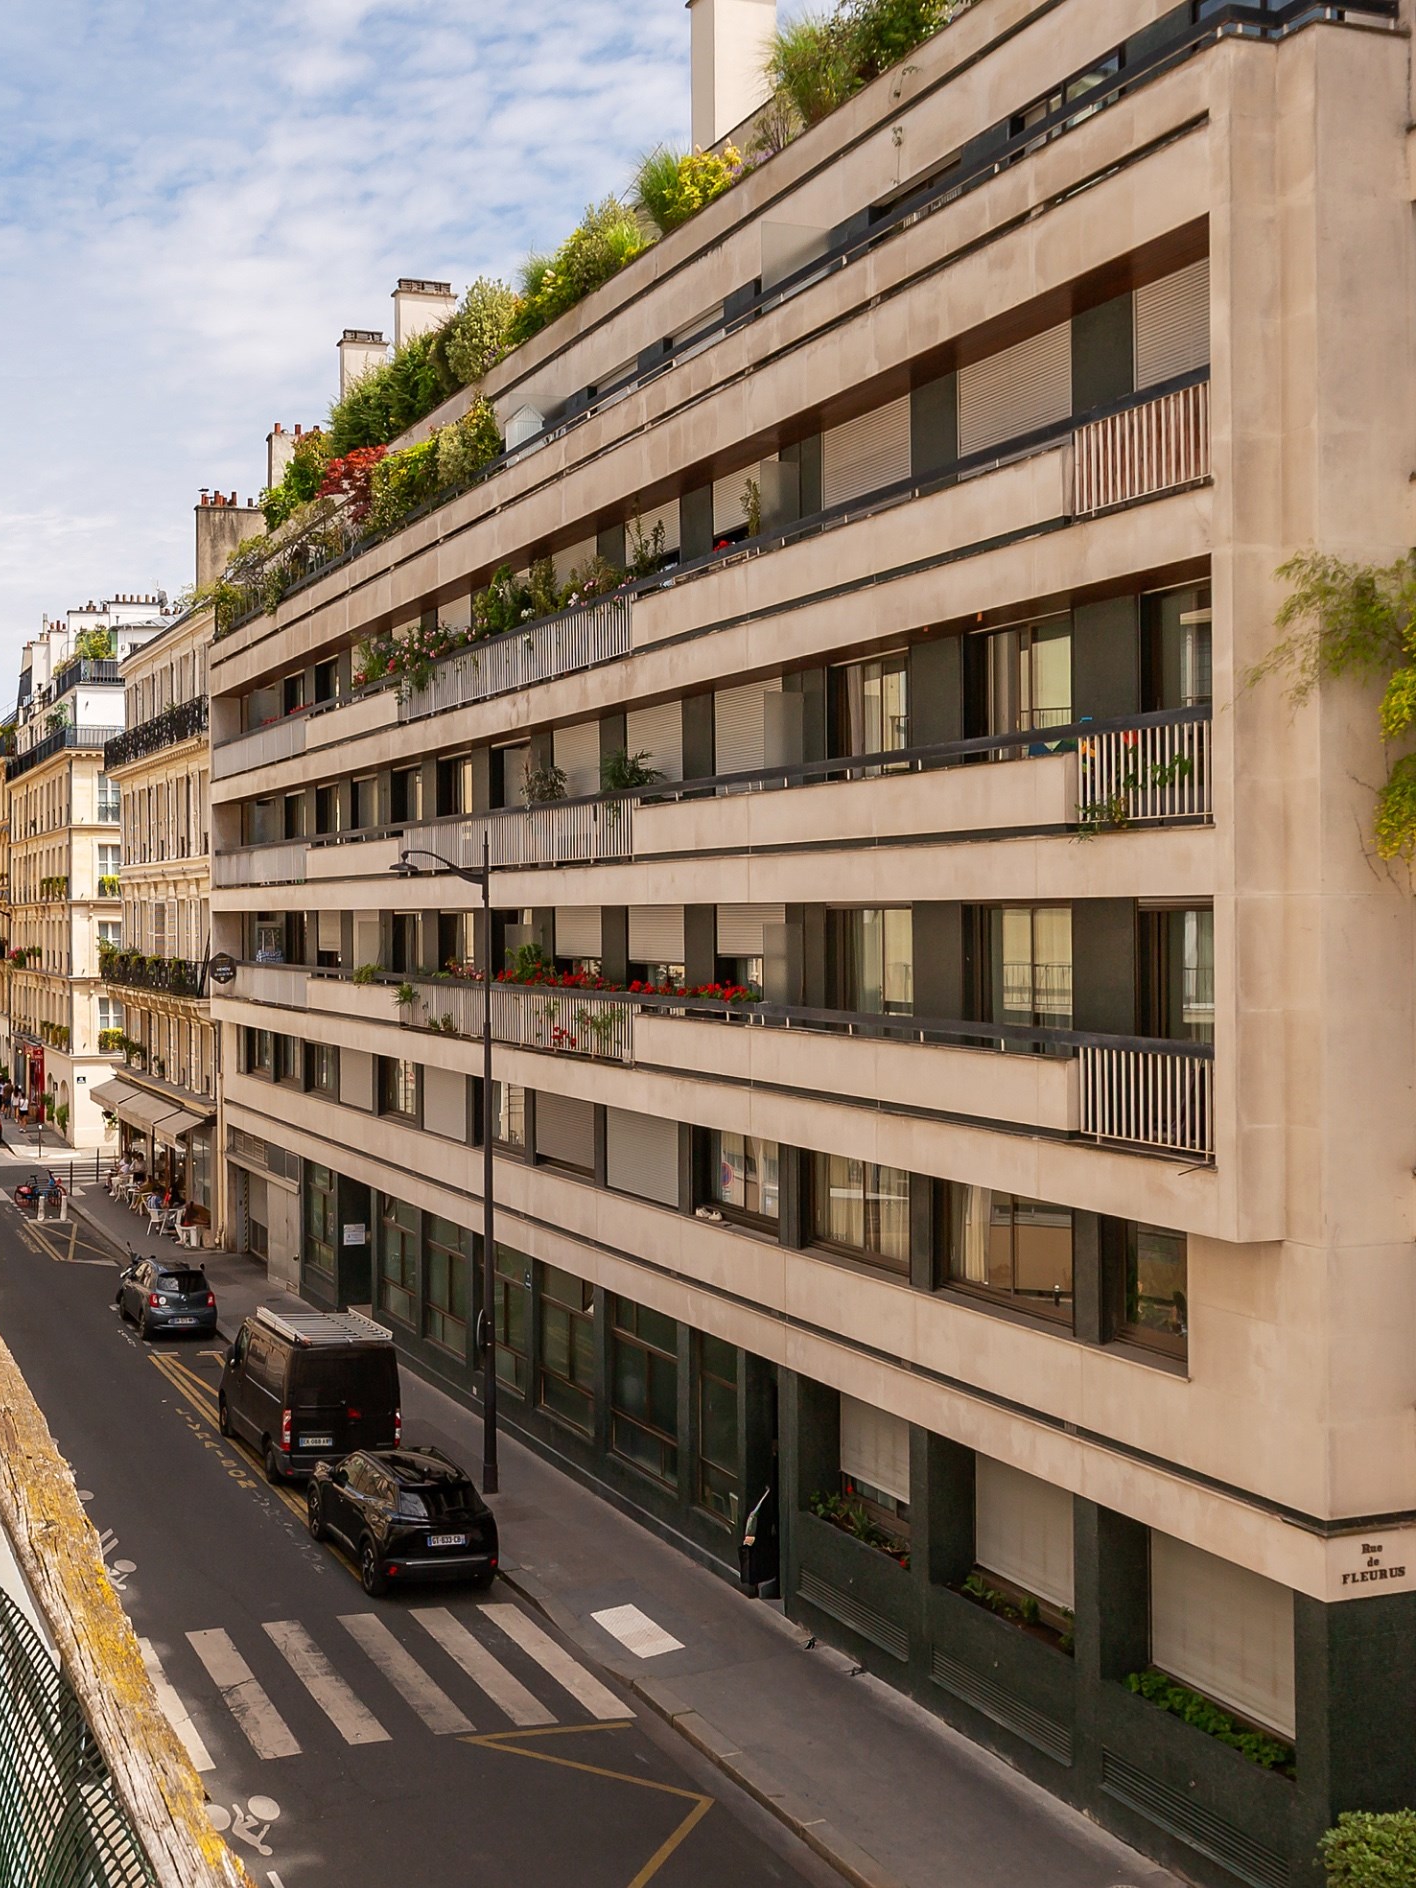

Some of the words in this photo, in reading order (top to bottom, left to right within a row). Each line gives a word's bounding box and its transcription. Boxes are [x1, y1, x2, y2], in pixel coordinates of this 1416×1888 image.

[1361, 1543, 1383, 1554] Rue
[1367, 1557, 1380, 1567] de
[1342, 1566, 1406, 1585] FLEURUS
